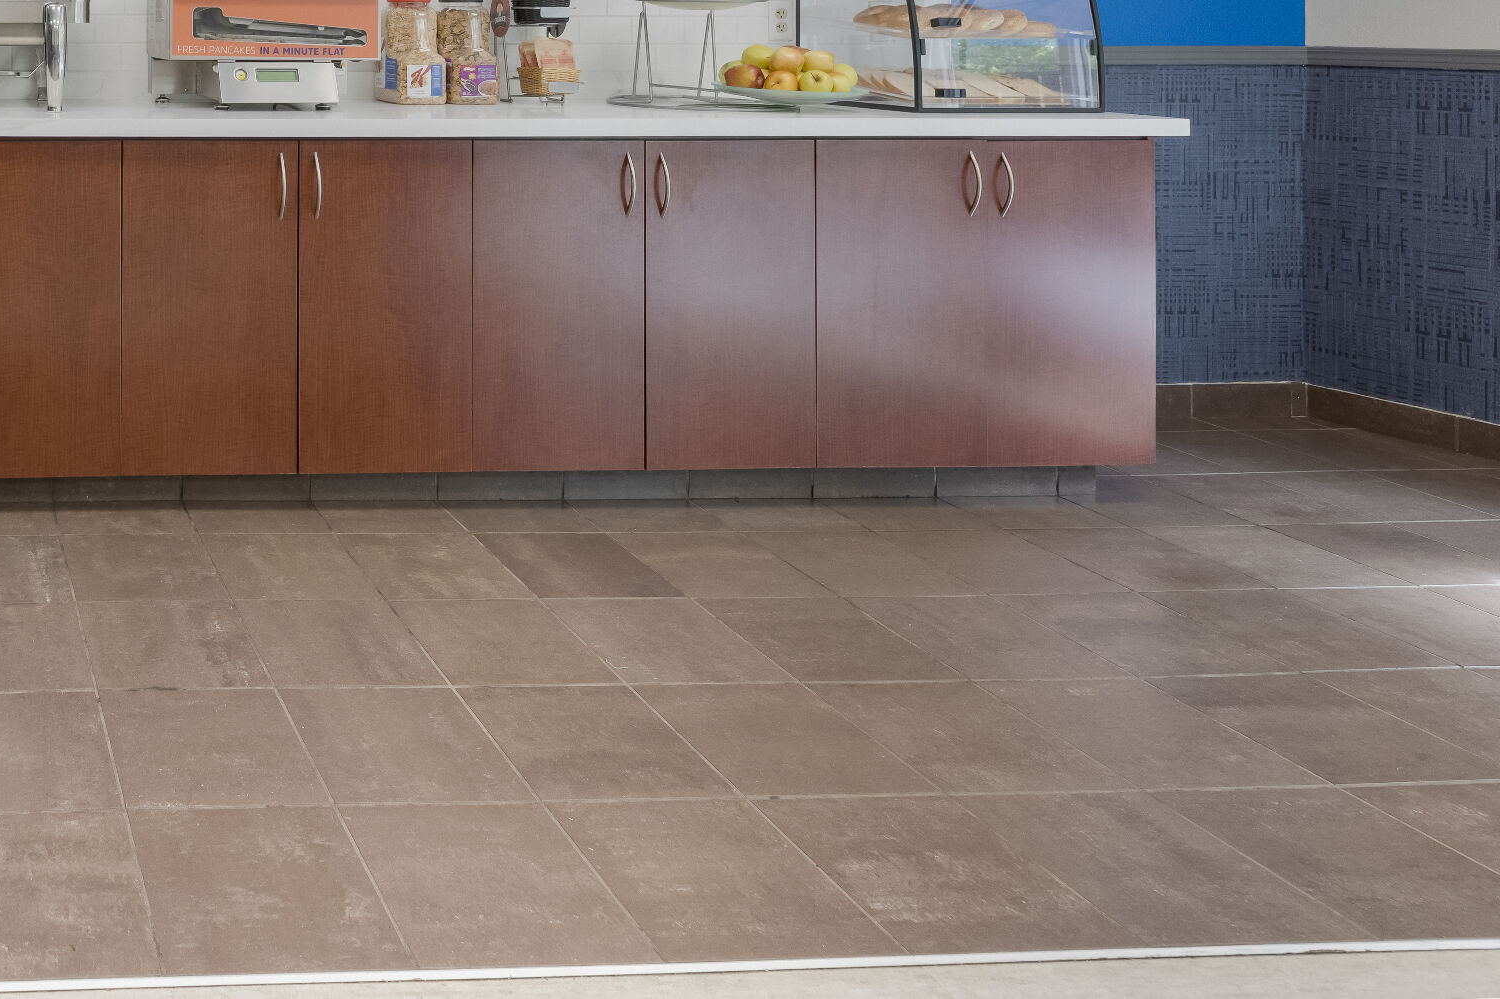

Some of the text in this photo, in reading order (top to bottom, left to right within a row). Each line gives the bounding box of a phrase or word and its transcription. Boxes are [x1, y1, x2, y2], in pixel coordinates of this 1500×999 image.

[177, 44, 345, 56] FRESH PANCAKES IN A MINUTE FLAT
